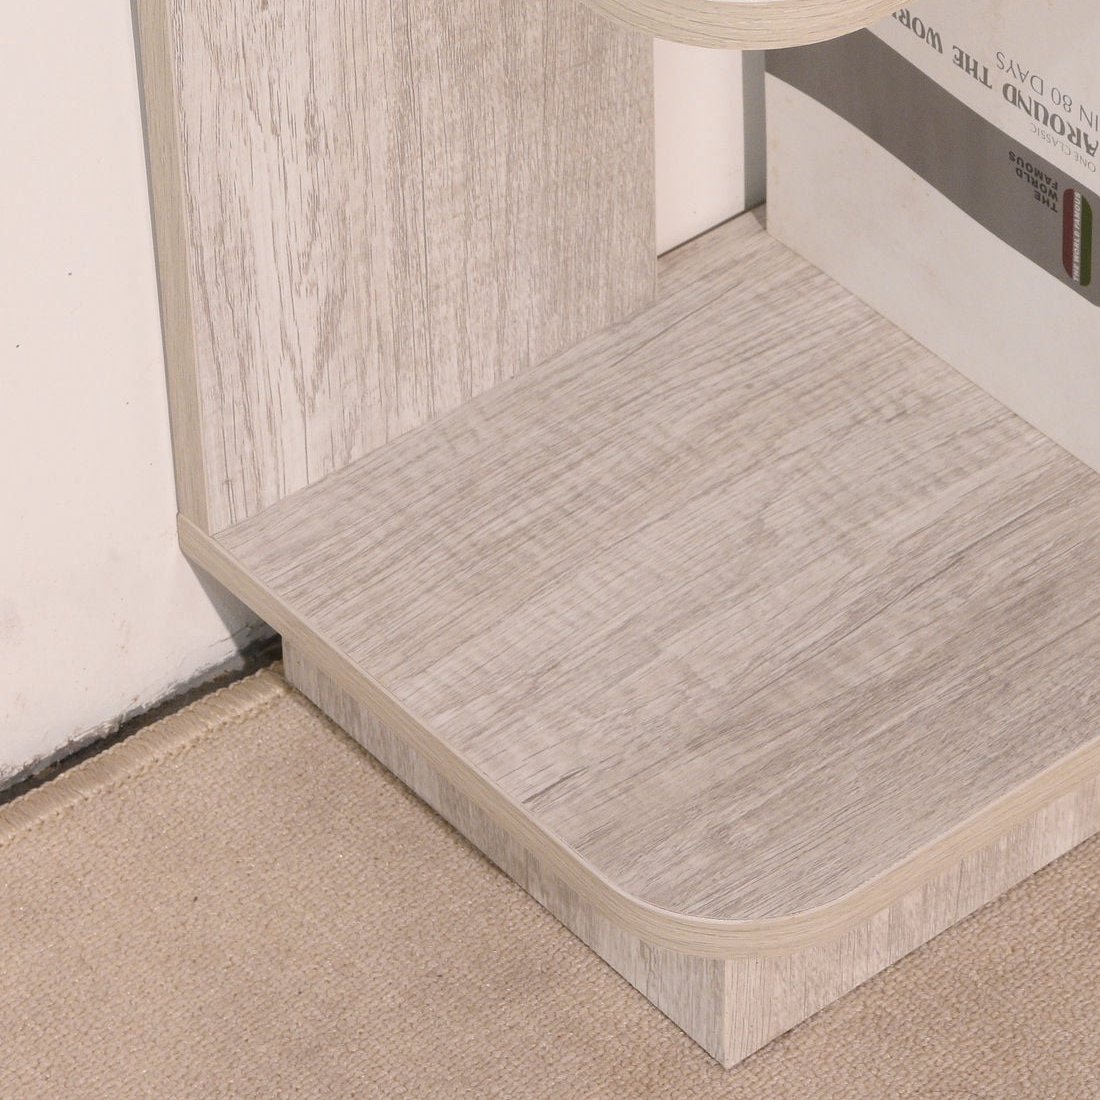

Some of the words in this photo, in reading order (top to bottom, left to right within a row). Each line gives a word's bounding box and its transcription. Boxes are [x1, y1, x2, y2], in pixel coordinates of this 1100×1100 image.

[892, 8, 944, 54] WOR
[952, 45, 993, 89] THE
[996, 51, 1044, 96] DAYS
[1051, 87, 1073, 113] 80
[1002, 82, 1099, 157] AROUND
[1079, 104, 1099, 131] IN
[1030, 123, 1071, 156] CLASSIC
[1009, 151, 1058, 190] FAMOUS
[1073, 153, 1097, 173] ONE
[1015, 167, 1058, 201] WORLD
[1034, 189, 1058, 213] THE
[1074, 191, 1082, 230] FAMOUS
[1073, 231, 1081, 263] WORLD
